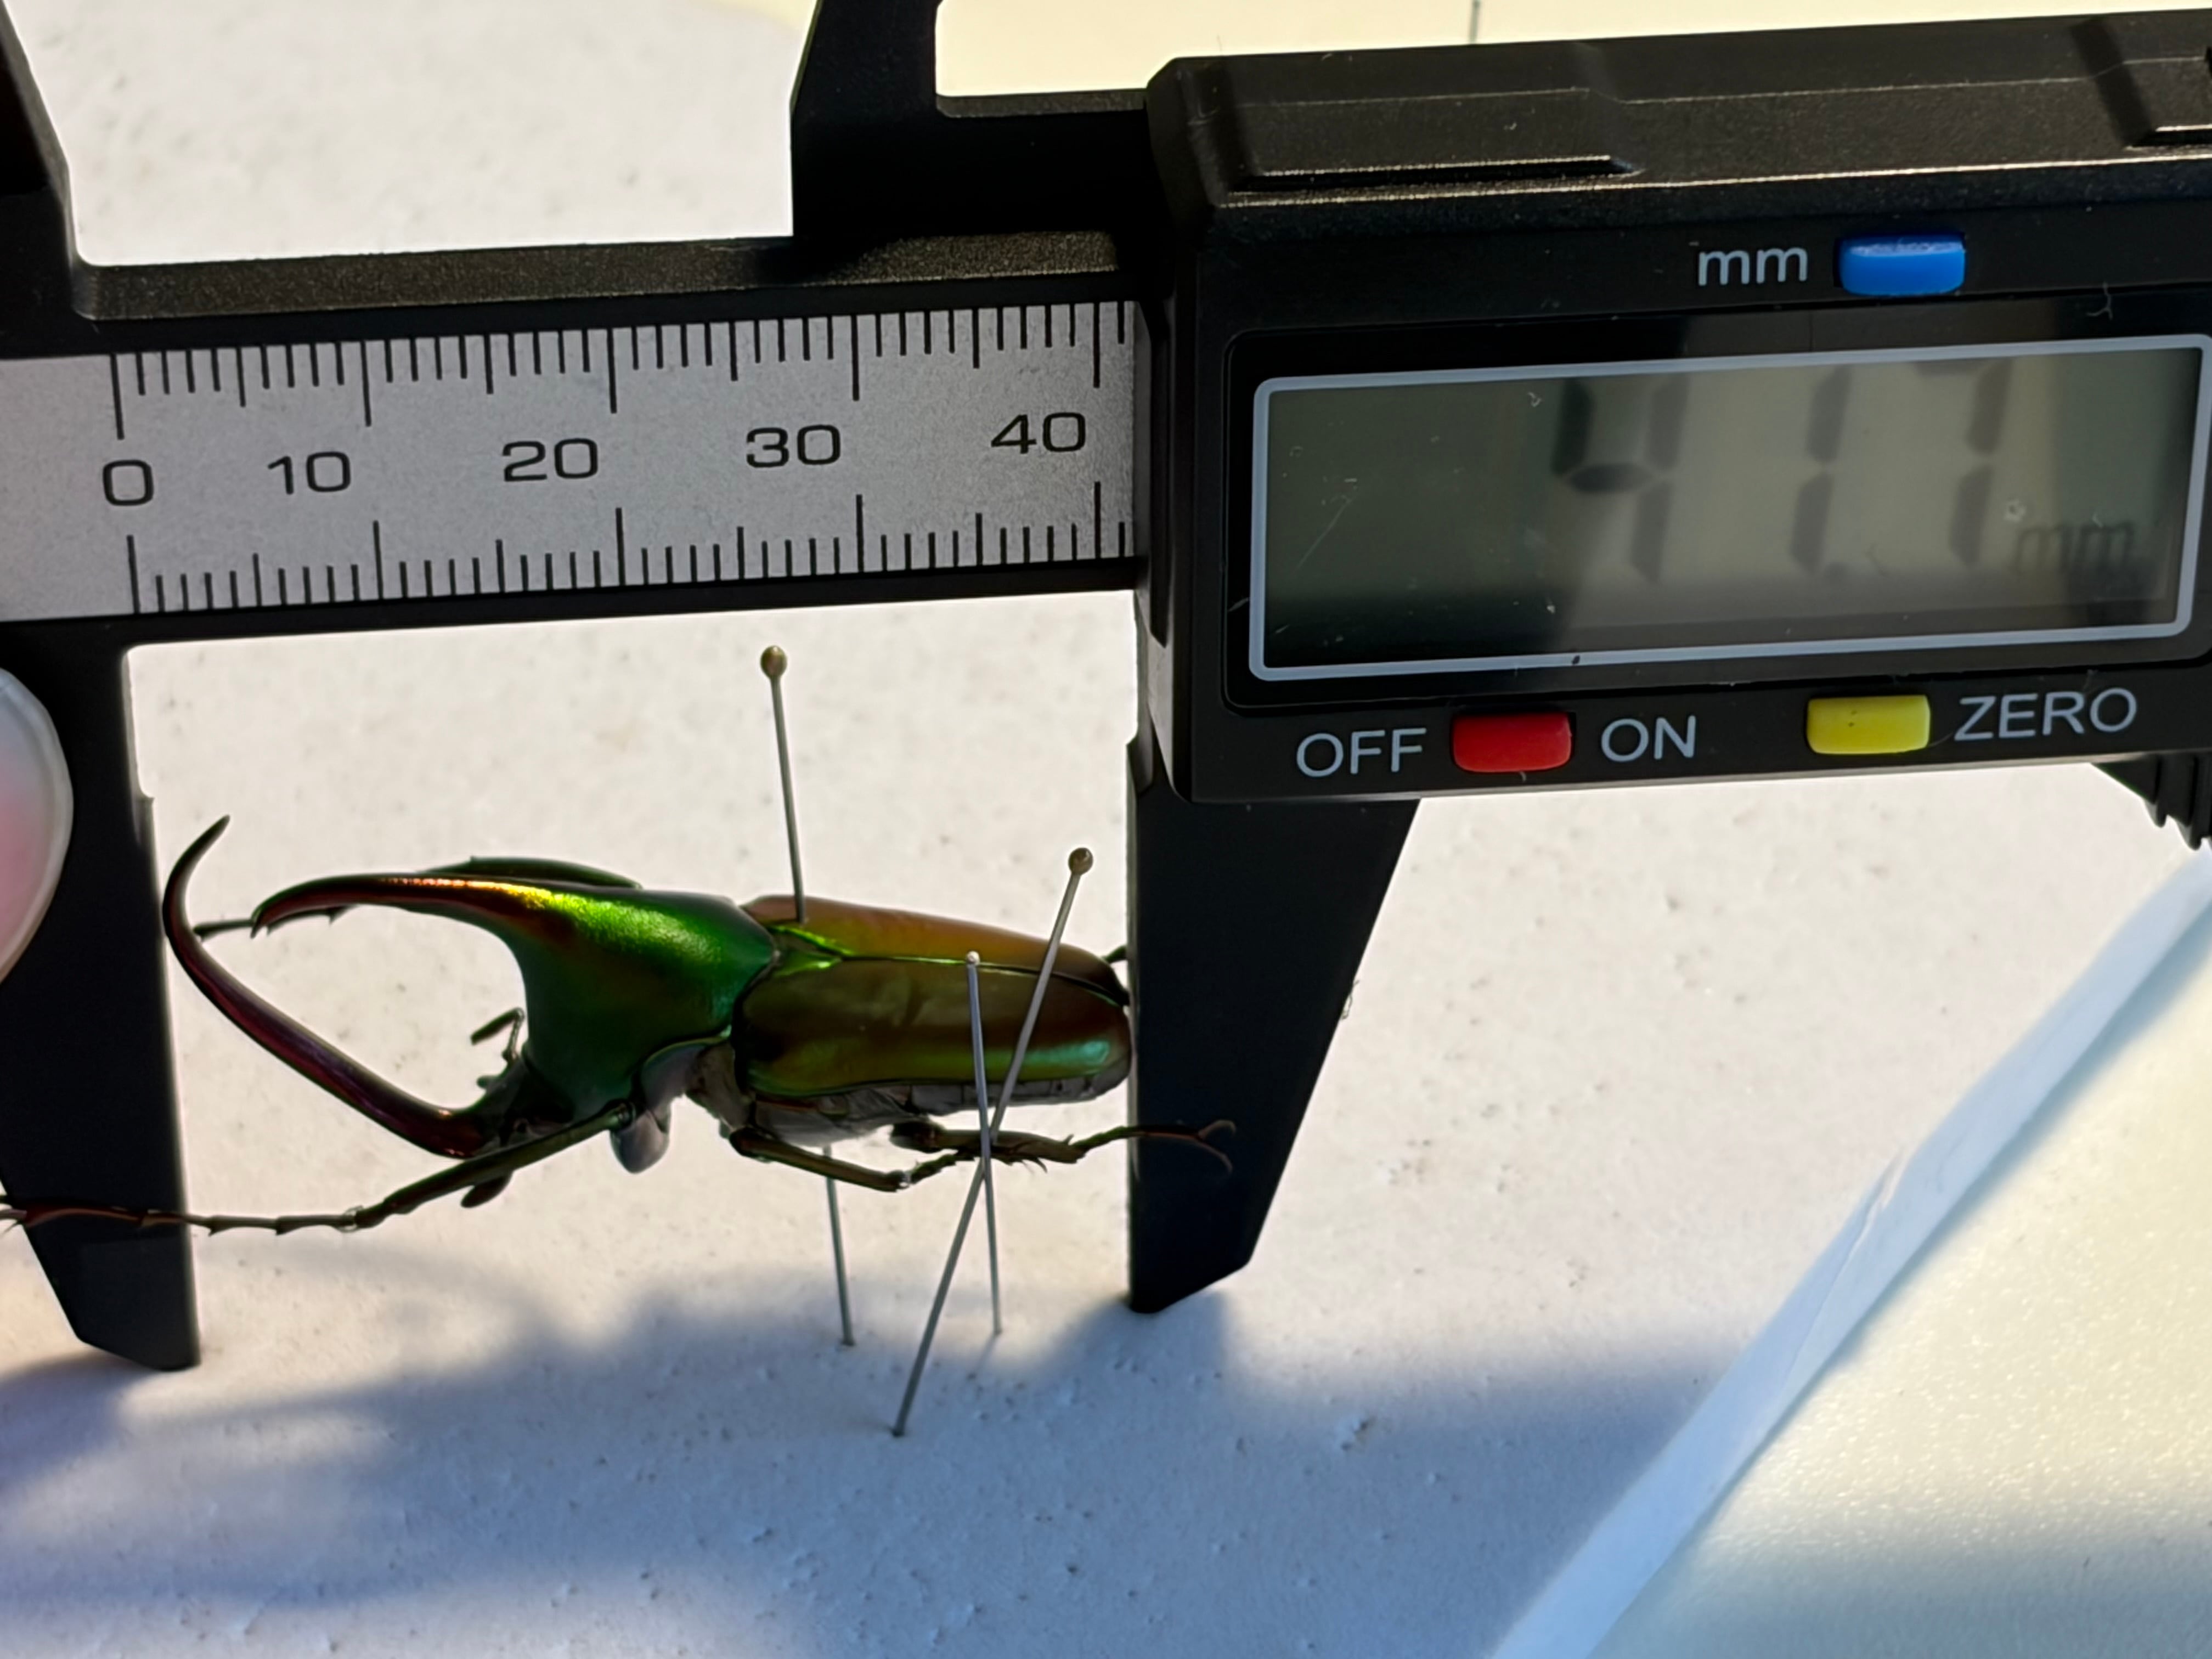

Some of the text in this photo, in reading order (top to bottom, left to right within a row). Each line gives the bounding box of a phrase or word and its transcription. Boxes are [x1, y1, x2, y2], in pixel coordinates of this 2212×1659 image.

[1698, 247, 1808, 286] mm
[102, 411, 1086, 506] 0 10 20 30 40
[2007, 519, 2137, 574] mm
[1600, 714, 1697, 762] ON
[1954, 687, 2138, 742] ZERO
[1295, 726, 1427, 778] OFF
